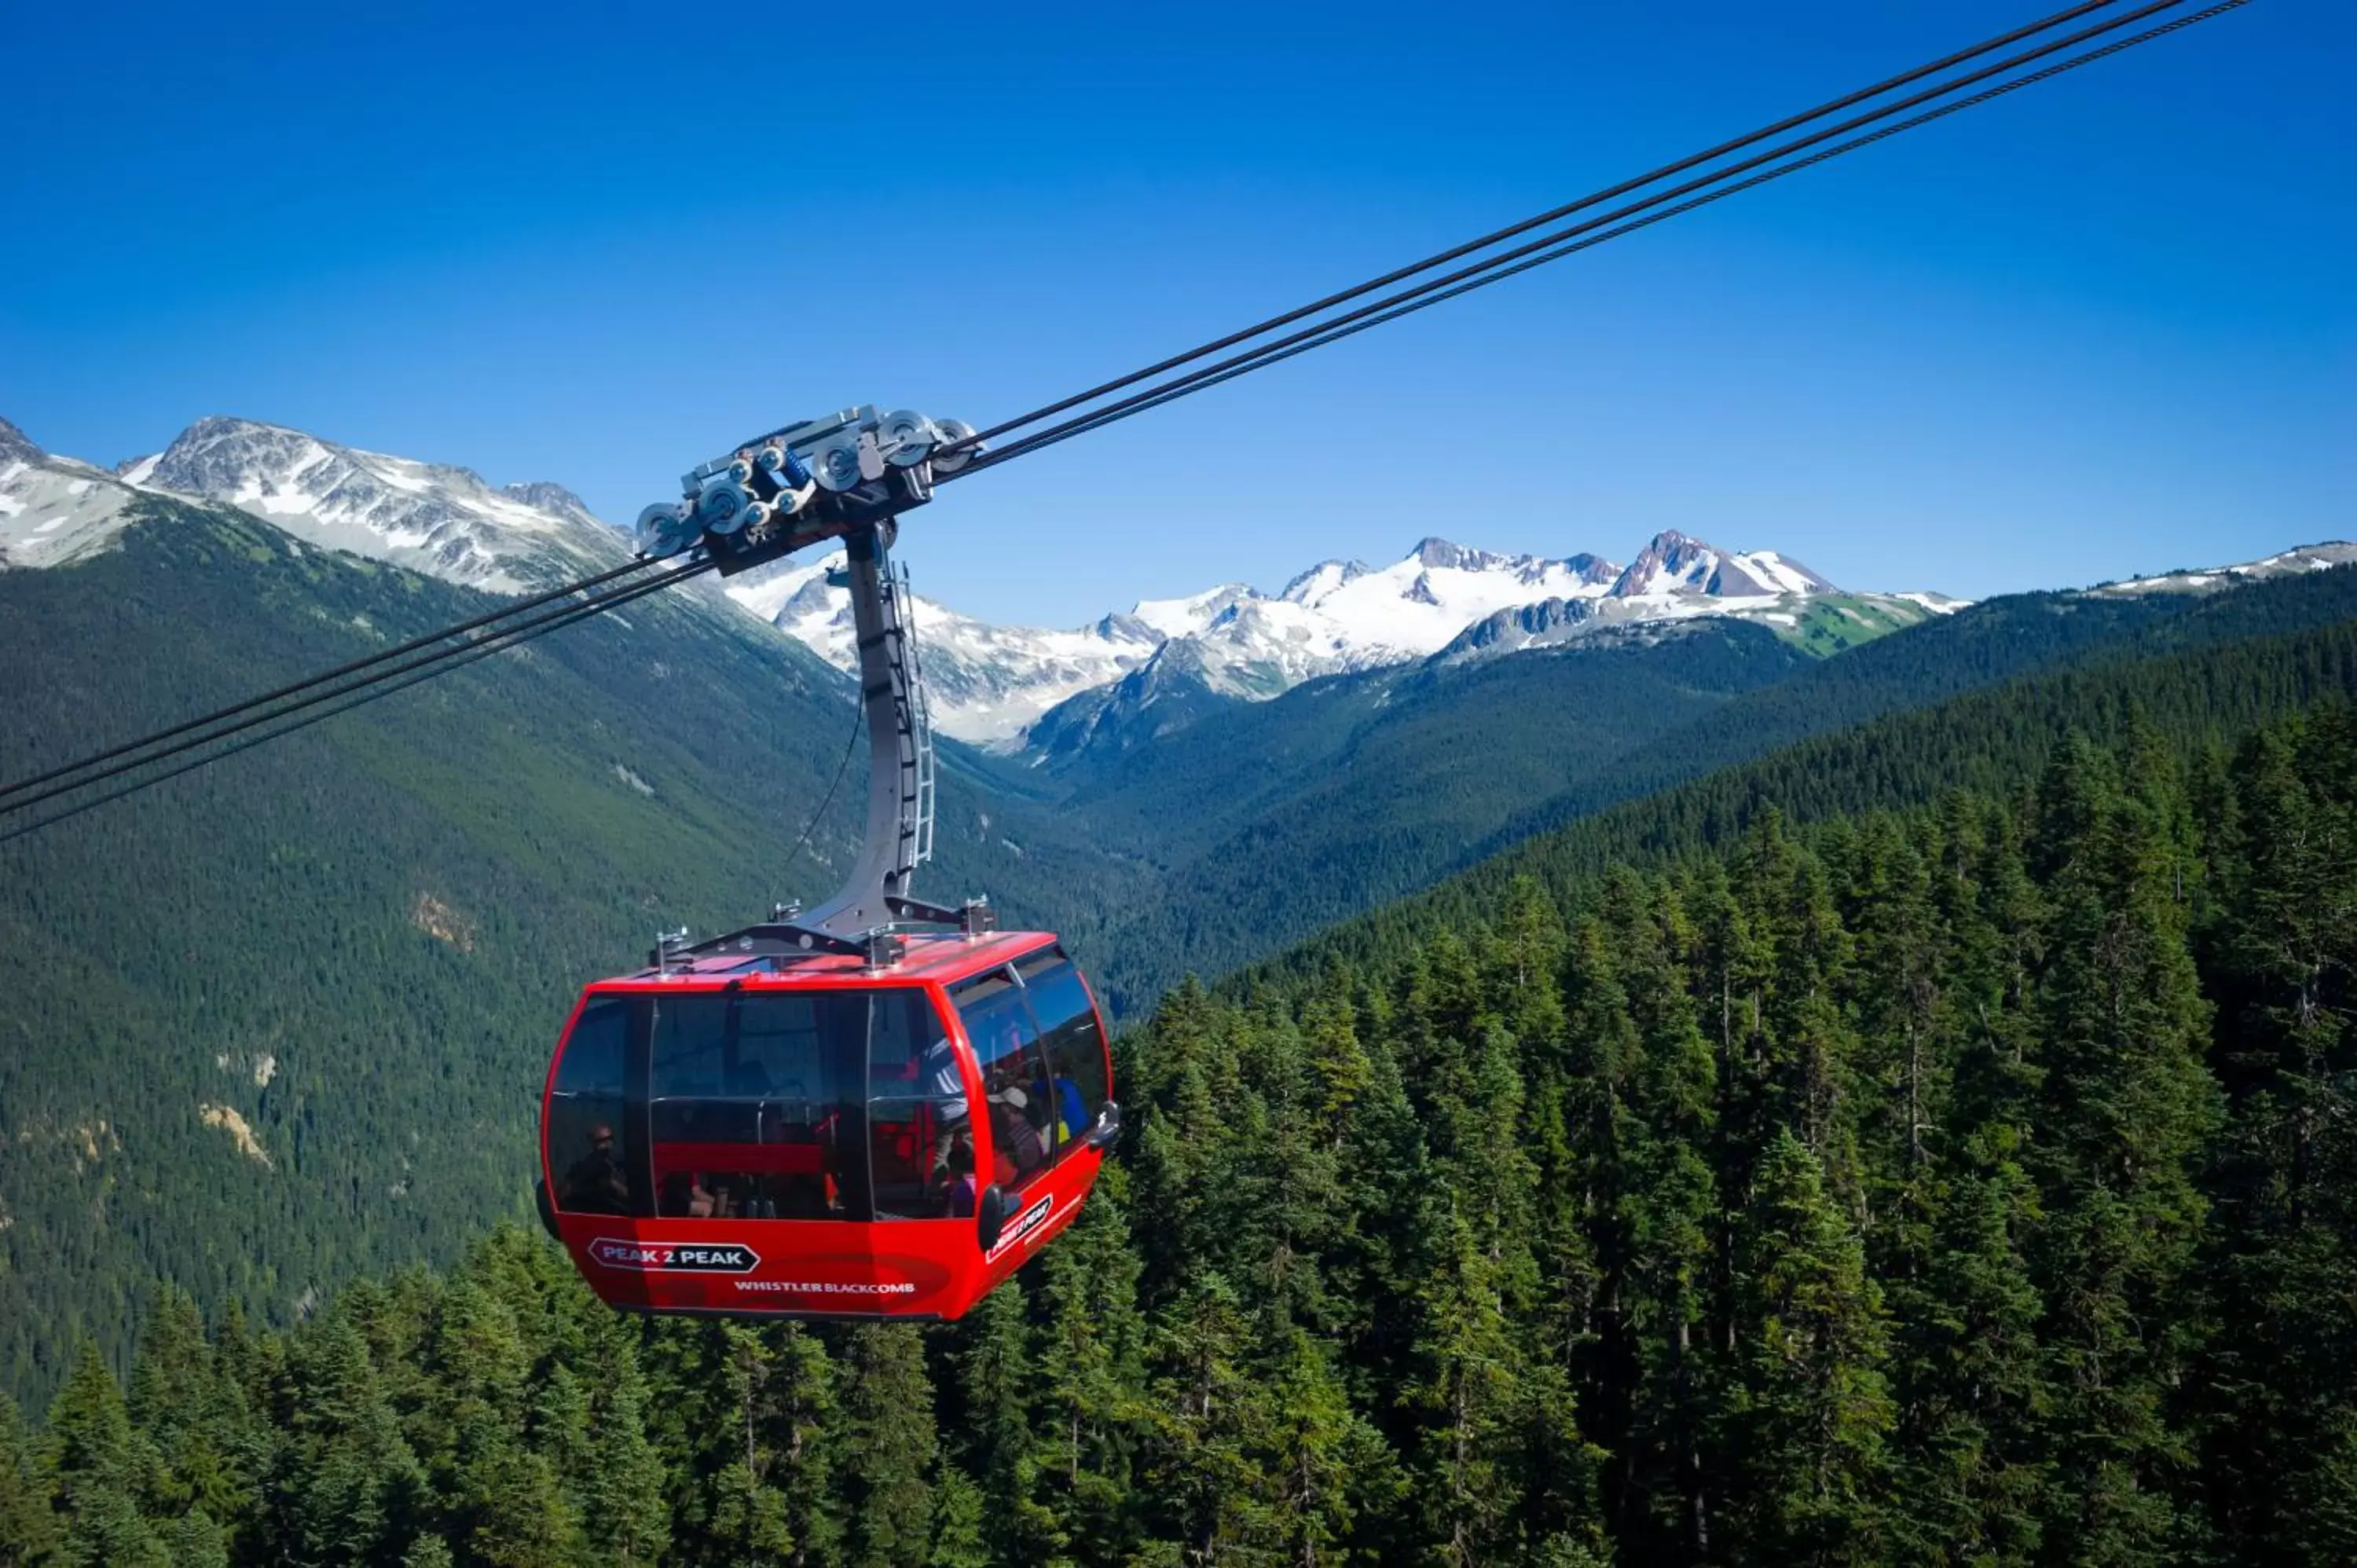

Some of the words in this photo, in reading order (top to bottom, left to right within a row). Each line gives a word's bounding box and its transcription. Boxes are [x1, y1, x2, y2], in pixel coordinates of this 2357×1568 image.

[603, 1246, 658, 1263] PEAK
[662, 1251, 676, 1263] 2
[680, 1251, 742, 1264] PEAK
